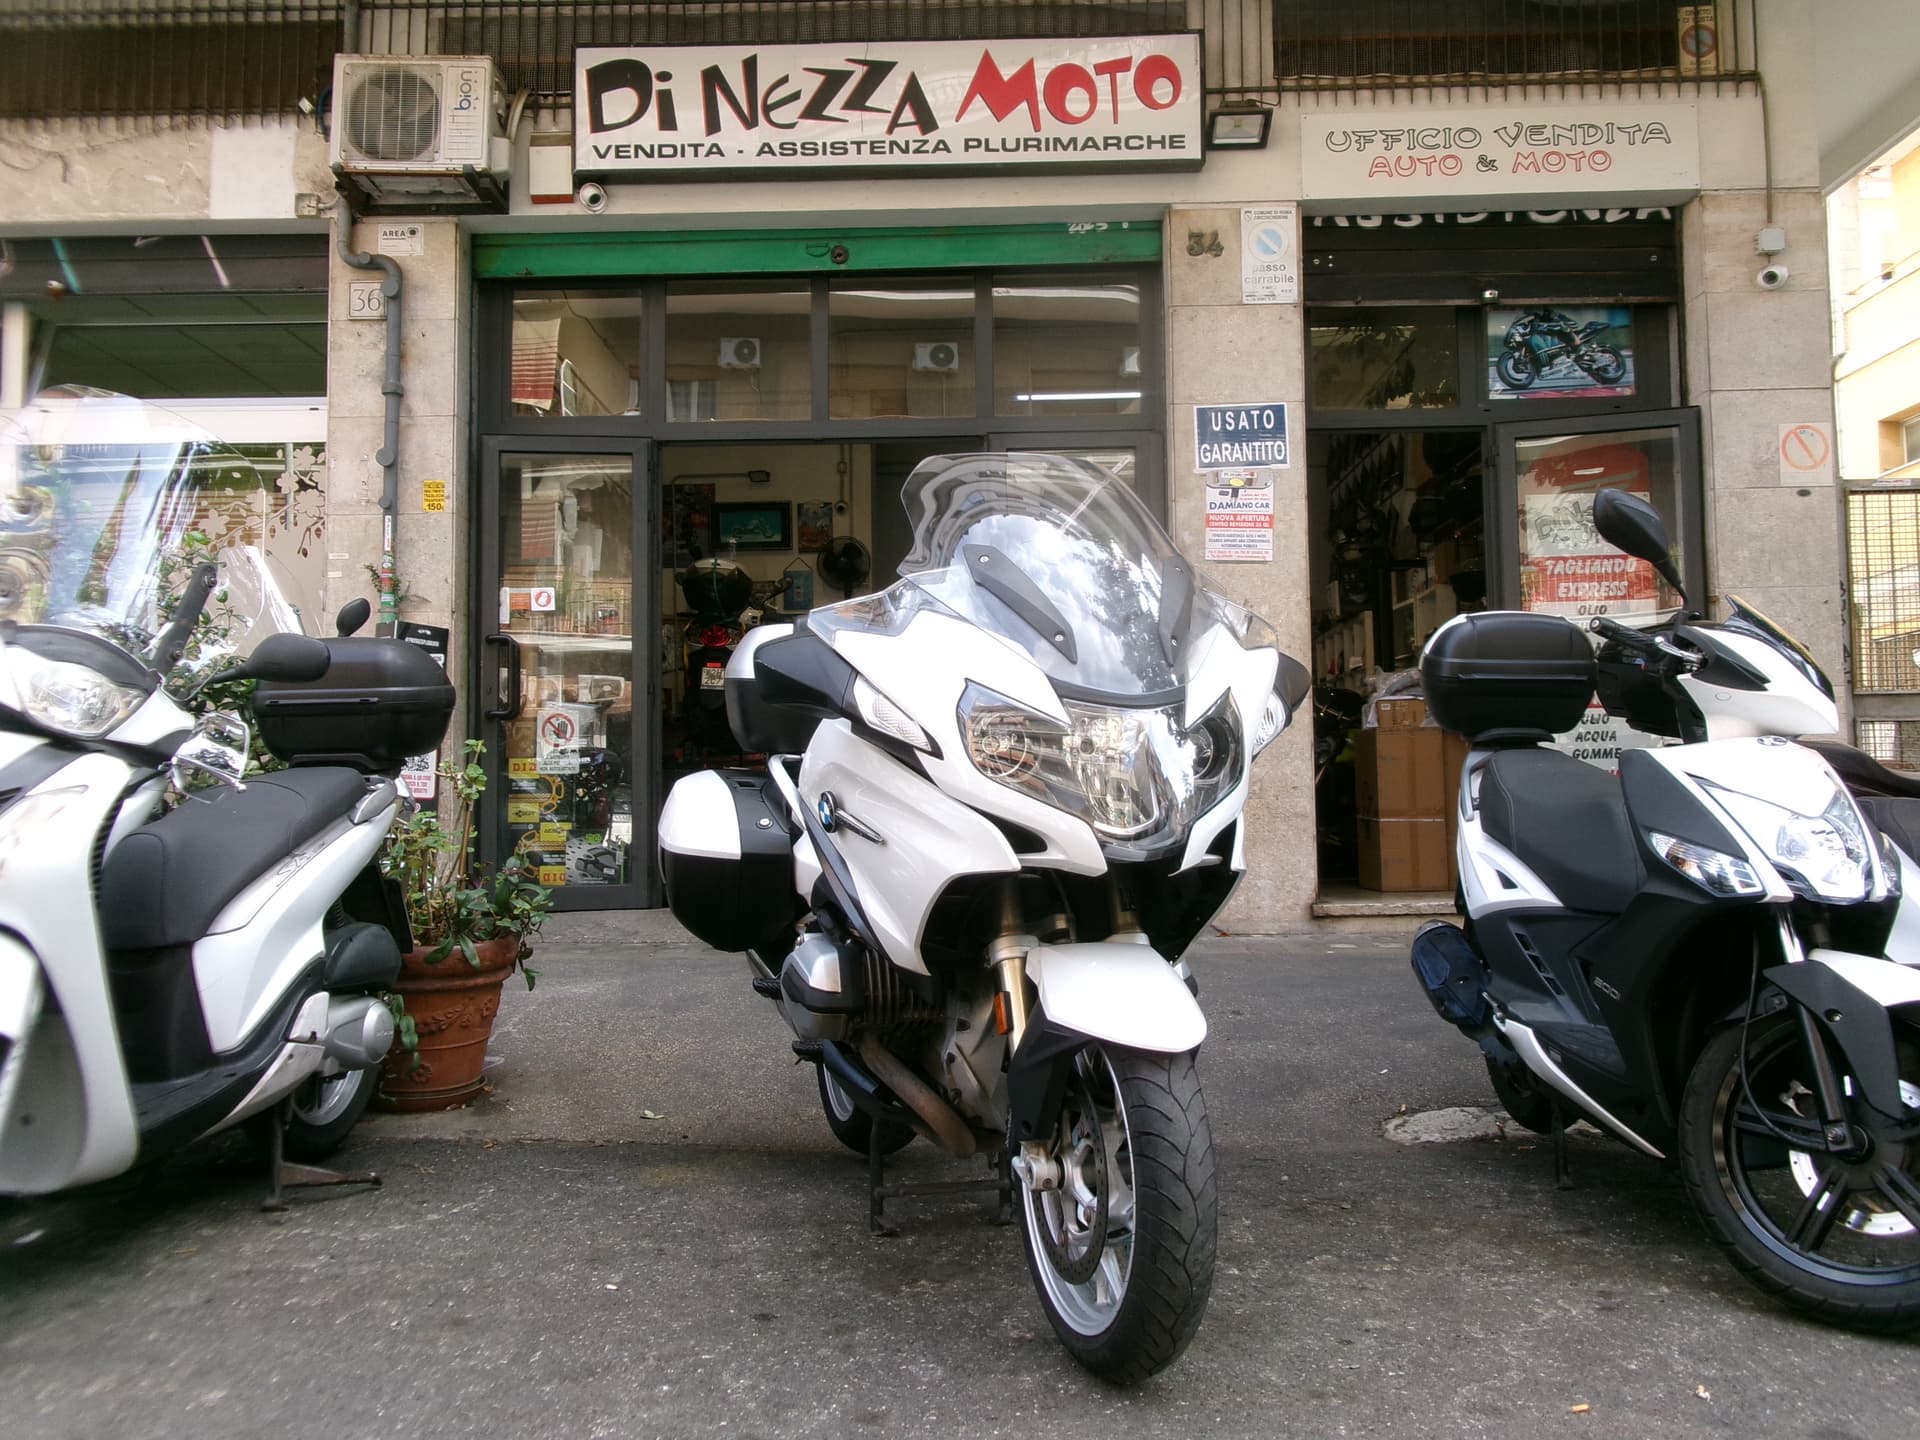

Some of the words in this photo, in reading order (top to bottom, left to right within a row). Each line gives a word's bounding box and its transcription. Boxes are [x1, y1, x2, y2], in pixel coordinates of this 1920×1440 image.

[585, 57, 679, 134] Di
[955, 48, 1183, 132] MOTO
[1326, 127, 1482, 152] UFFICIO
[1494, 121, 1671, 148] VENDITA
[592, 142, 725, 160] VENDITA
[756, 137, 953, 157] ASSISTENZA
[963, 133, 1187, 153] PLURIMARCHE
[1368, 154, 1463, 178] AUTO
[1475, 155, 1498, 173] &
[1512, 150, 1612, 174] MOTO
[1252, 264, 1287, 273] passo
[1244, 274, 1294, 284] carrabile
[351, 288, 382, 312] 36
[1211, 409, 1275, 432] USATO
[1200, 440, 1285, 463] GARANTITO
[1209, 501, 1253, 510] DAMIANO
[1545, 558, 1637, 575] TAGLIANDO
[1558, 581, 1628, 597] EXPRESS
[1578, 604, 1607, 616] OLIO
[1575, 731, 1617, 743] ACQUA
[1572, 748, 1623, 760] GOMME
